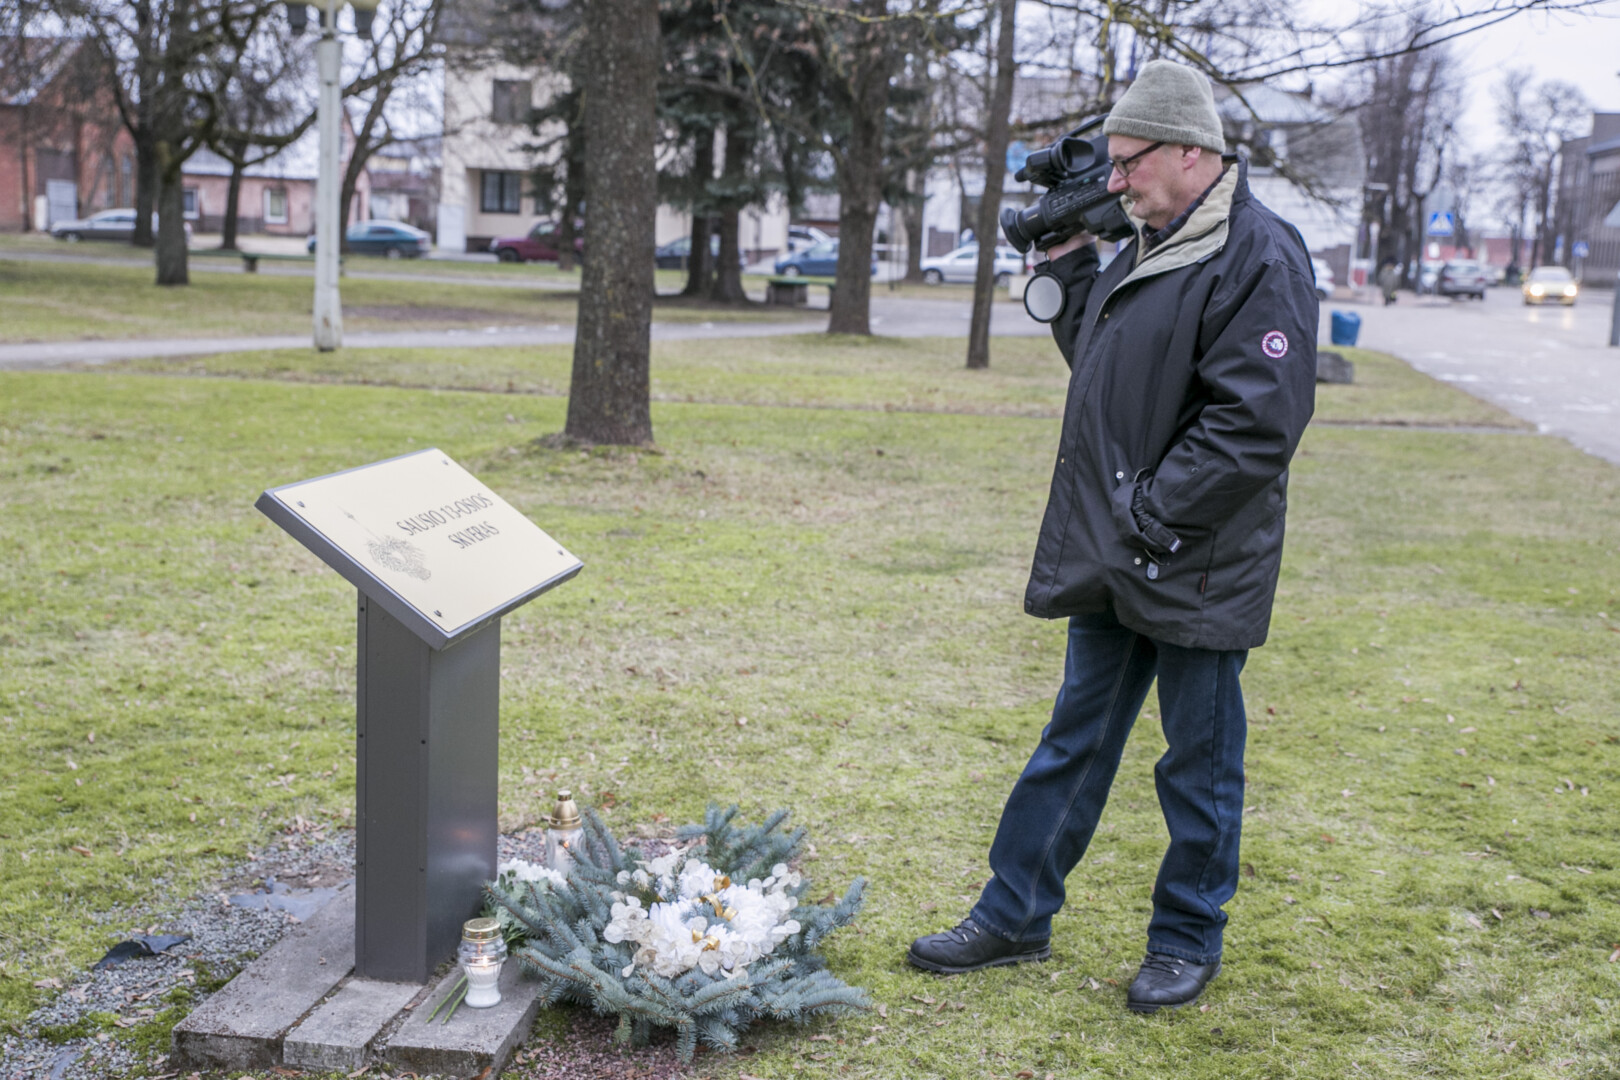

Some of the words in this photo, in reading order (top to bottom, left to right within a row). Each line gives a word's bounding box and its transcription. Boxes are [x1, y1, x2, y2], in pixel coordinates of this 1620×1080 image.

[396, 510, 447, 536] SAUSIO
[440, 493, 494, 520] 13-OSIOS
[448, 520, 500, 549] SKVERAS
